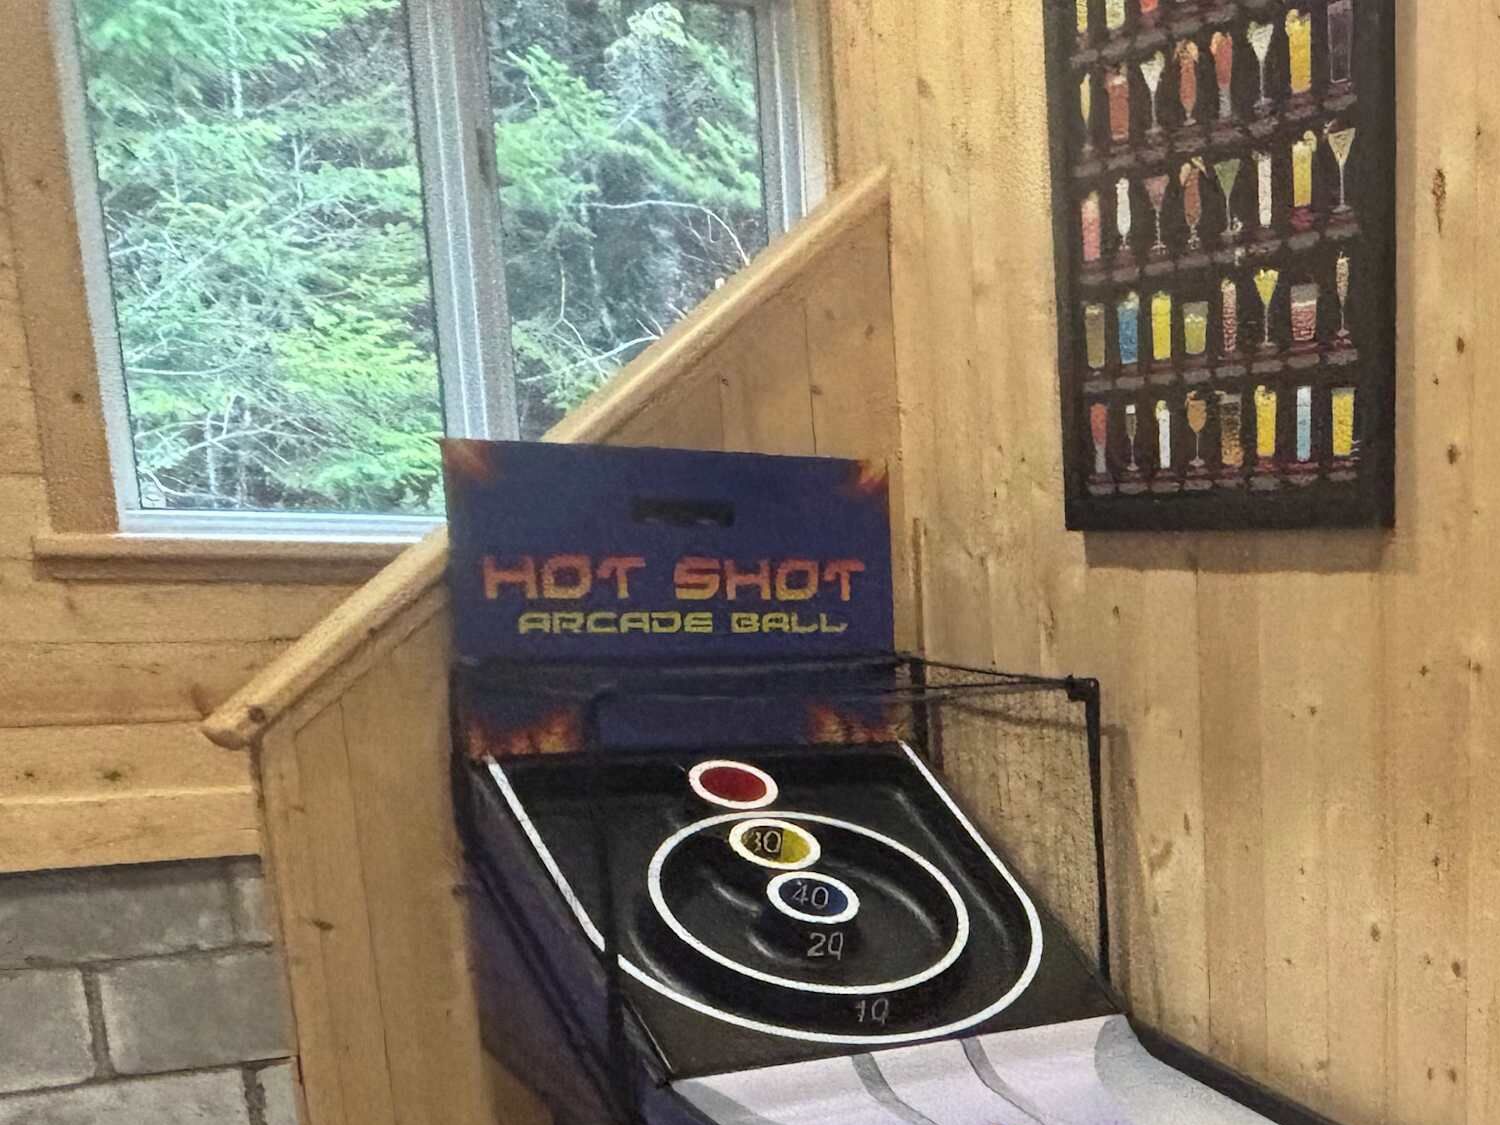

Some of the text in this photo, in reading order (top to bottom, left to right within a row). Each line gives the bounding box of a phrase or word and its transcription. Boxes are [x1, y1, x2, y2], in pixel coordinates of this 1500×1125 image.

[482, 554, 866, 602] HOT SHOT
[518, 610, 849, 634] ARCADE BALL
[791, 881, 829, 909] 40
[806, 930, 844, 961] 20
